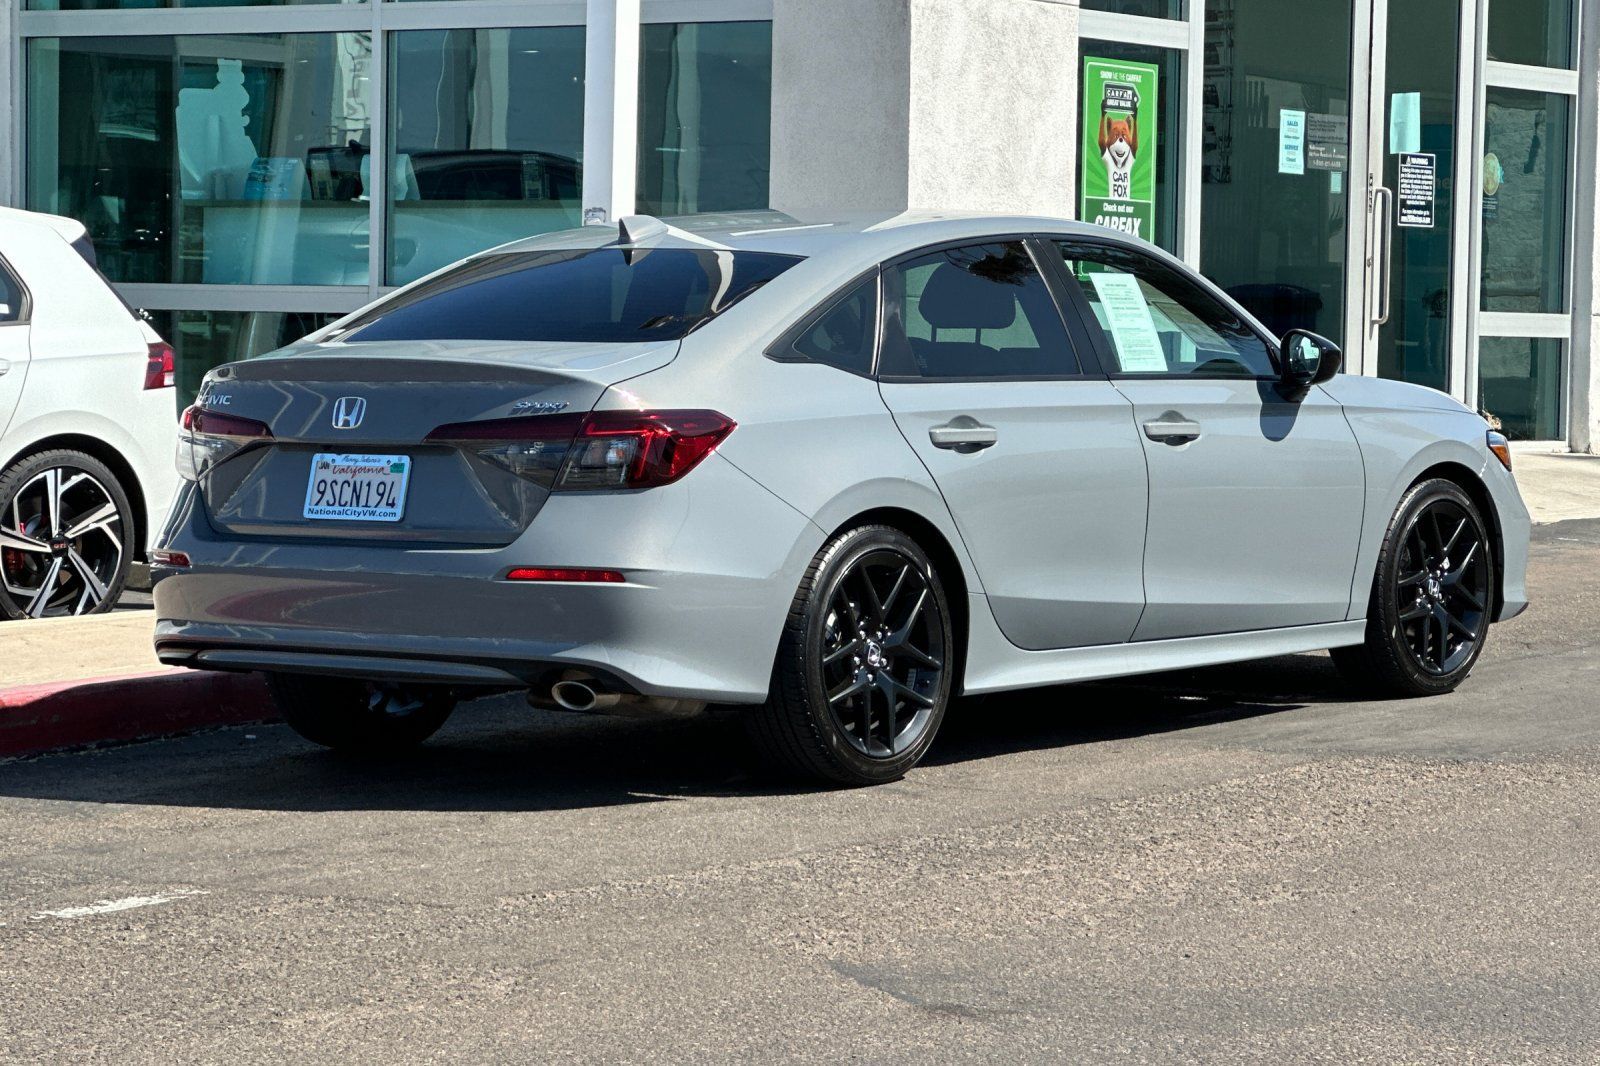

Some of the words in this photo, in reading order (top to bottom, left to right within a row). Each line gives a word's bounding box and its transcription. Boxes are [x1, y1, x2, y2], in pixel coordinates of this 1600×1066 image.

[1112, 171, 1128, 183] CAR
[1112, 184, 1128, 197] FOX
[1103, 202, 1117, 212] Check
[1117, 204, 1126, 213] out
[1125, 205, 1134, 213] our
[319, 461, 330, 470] JAN
[332, 465, 390, 479] California
[314, 479, 397, 508] 9SCN194
[307, 507, 397, 518] NationalCityVW.com
